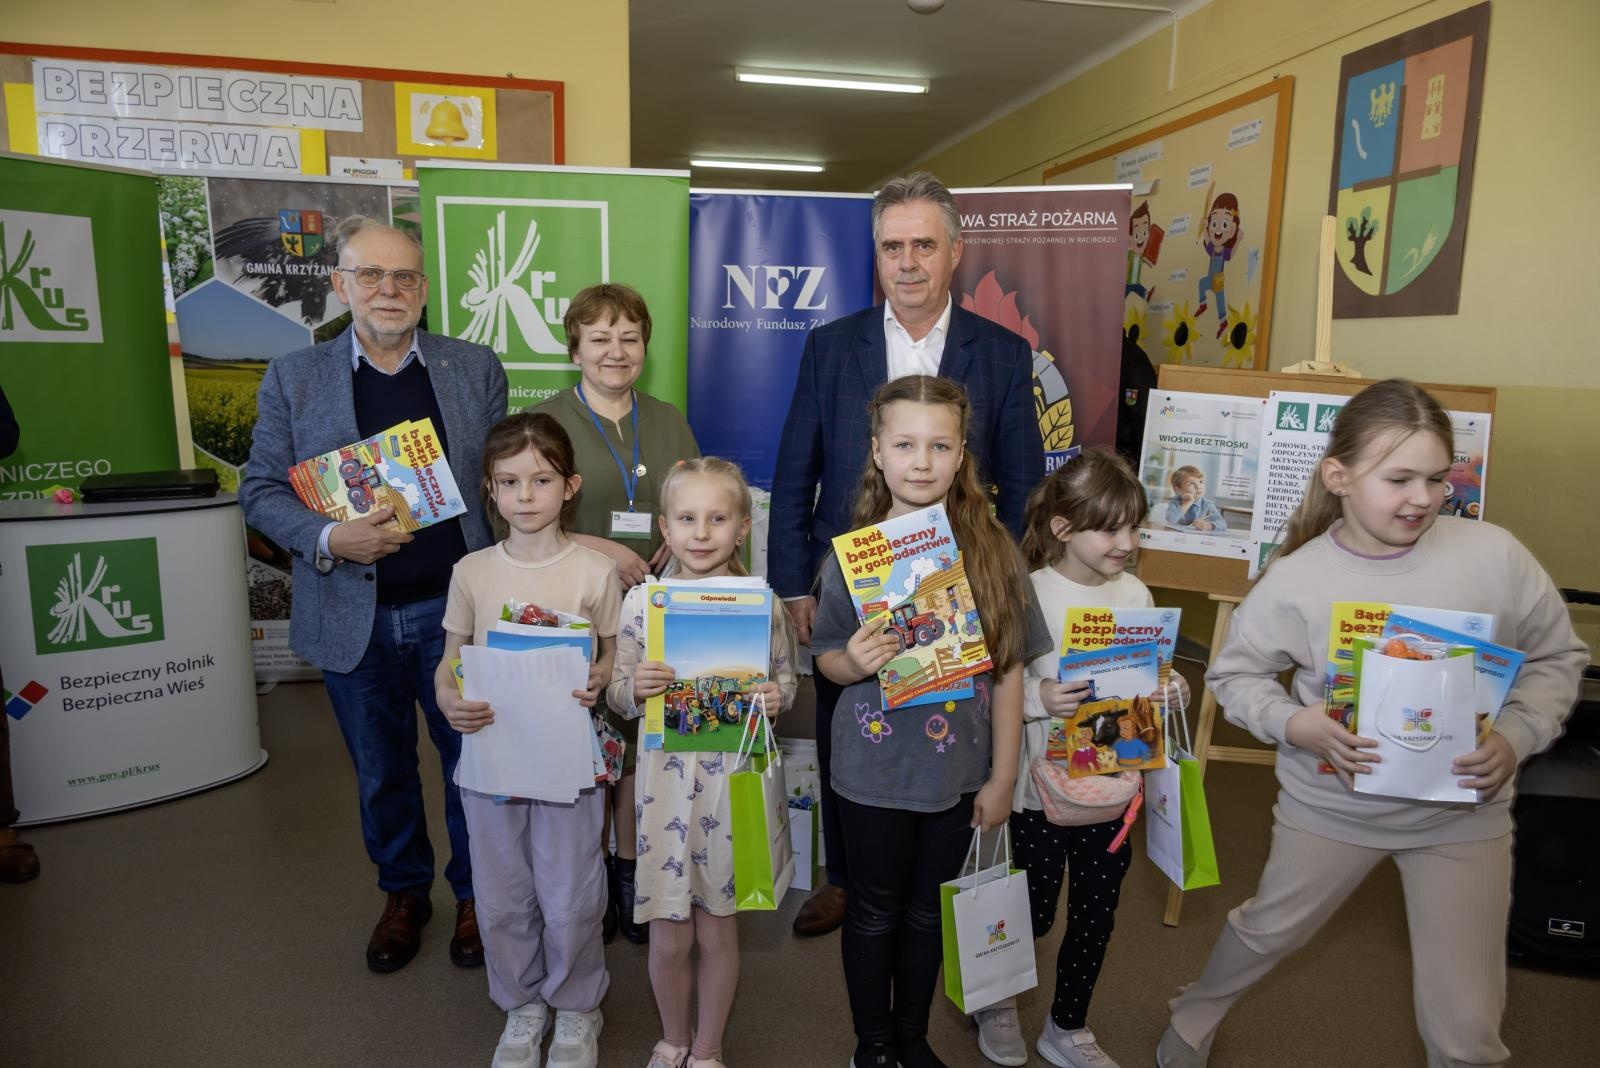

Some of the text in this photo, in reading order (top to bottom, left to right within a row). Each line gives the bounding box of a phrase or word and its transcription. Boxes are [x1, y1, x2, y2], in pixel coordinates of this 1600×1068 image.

[42, 66, 362, 121] BEZPIECZNA
[46, 122, 298, 169] PRZERWA
[989, 209, 1038, 227] STRAŻ
[1041, 208, 1118, 227] POŻARNA
[964, 238, 1004, 246] AŃSTWOWEJ
[246, 262, 283, 275] GMINA
[722, 264, 829, 311] NFZ
[690, 317, 752, 333] Narodowy
[757, 318, 806, 331] Fundusz
[422, 434, 440, 461] Bądź
[1159, 434, 1193, 445] WIOSKI
[1194, 437, 1213, 447] BEZ
[1214, 439, 1249, 450] TROSKI
[401, 433, 440, 519] w gospodarstwie
[409, 429, 447, 507] bezpieczny
[846, 526, 937, 564] bezpieczny
[852, 529, 884, 549] Bądź
[852, 536, 951, 575] w gospodarstwie
[700, 594, 737, 603] Odpowiedzi
[1071, 622, 1164, 638] bezpieczny
[1083, 613, 1114, 625] Bądź
[1071, 637, 1080, 645] w
[1113, 654, 1128, 662] NA
[60, 653, 215, 693] Bezpieczny Rolnik
[62, 675, 205, 713] Bezpieczna Wieś
[67, 760, 161, 788] www.gov.pl/krus
